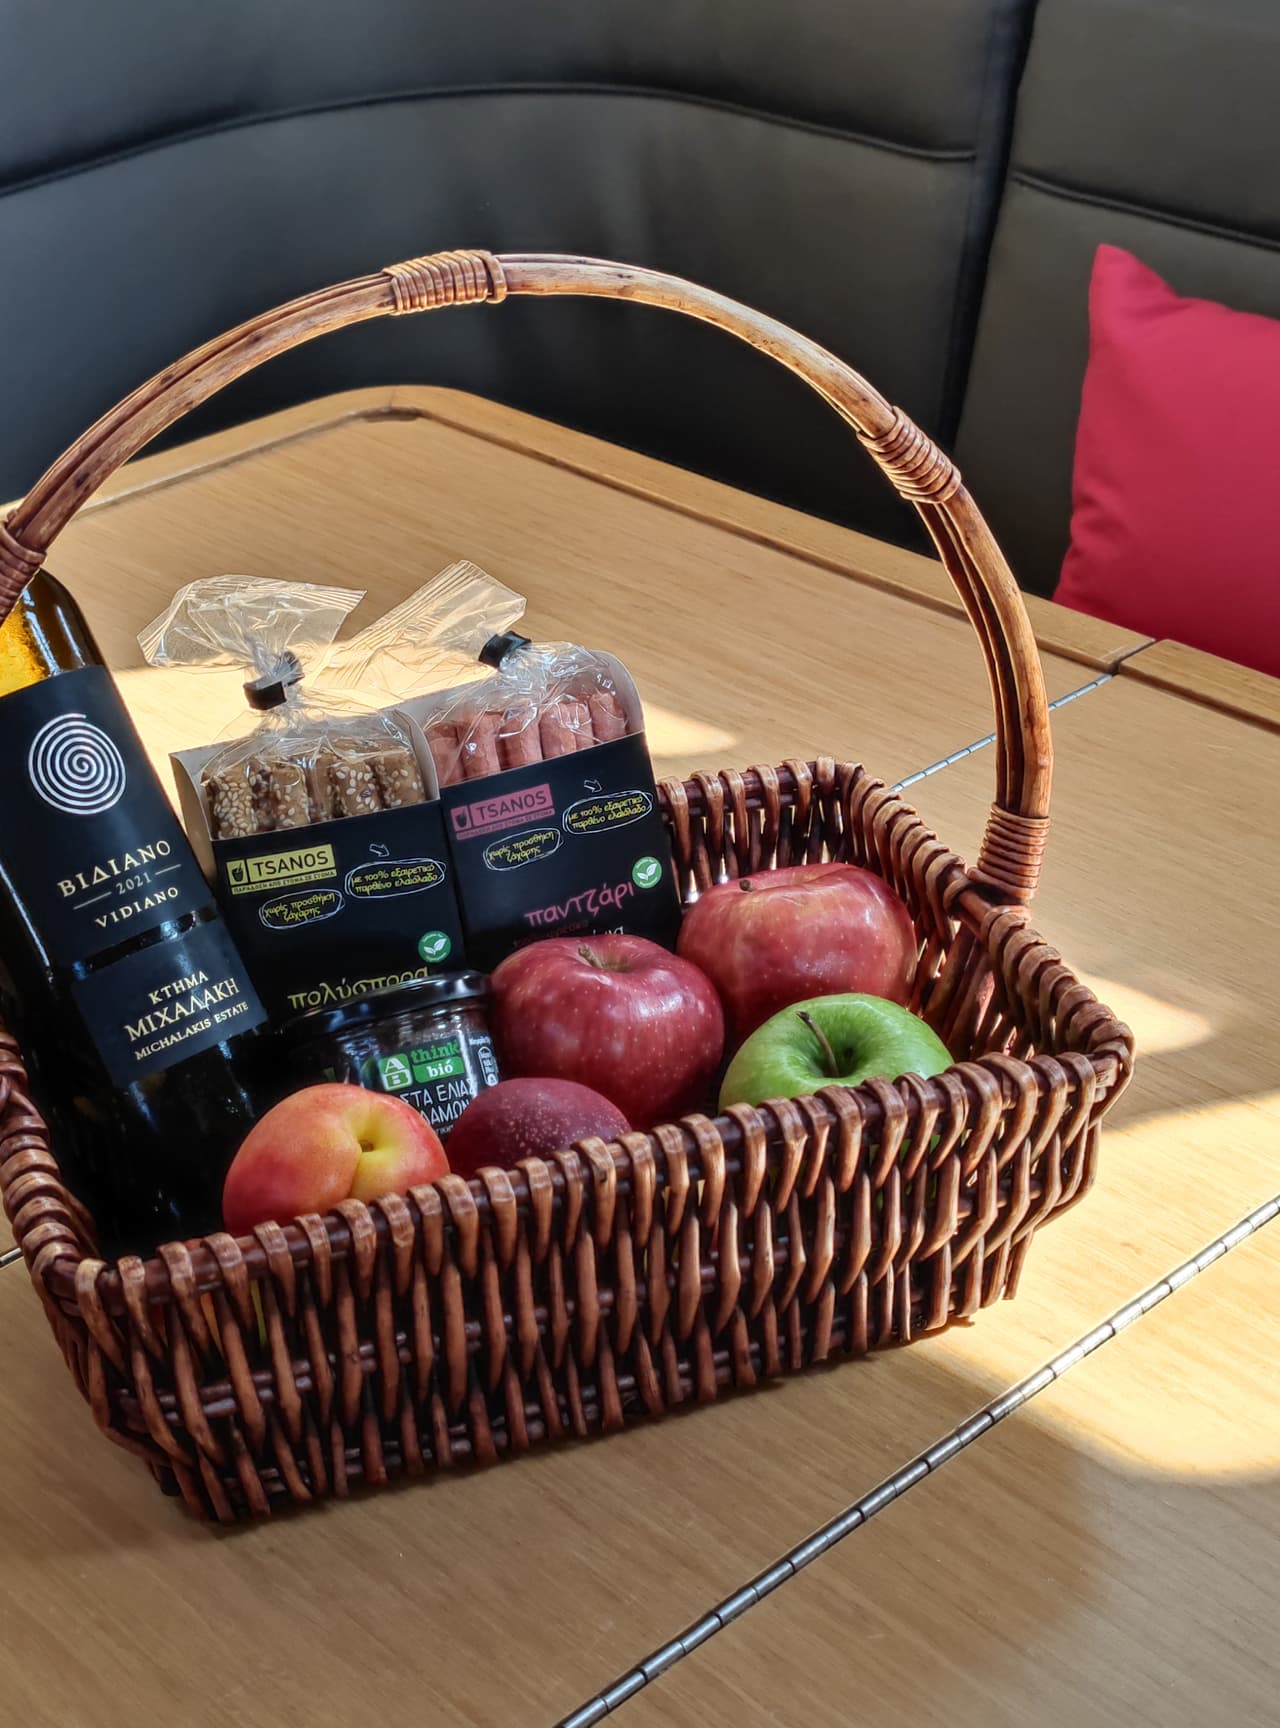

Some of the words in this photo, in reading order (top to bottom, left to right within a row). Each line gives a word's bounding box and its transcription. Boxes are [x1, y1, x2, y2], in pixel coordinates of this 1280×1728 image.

[476, 790, 547, 820] TSANOS
[580, 804, 603, 817] 100%
[57, 840, 171, 897] ΒΙΔΙΑΝΟ
[252, 850, 329, 877] TSANOS
[365, 870, 390, 881] 100%
[115, 871, 152, 895] 2021
[95, 887, 179, 928] VIDIANO
[523, 881, 635, 927] παντζάρι
[148, 970, 209, 1005] ΚΤΗΜΑ
[123, 978, 240, 1042] ΜΙΧΑΛΑΚΗ
[134, 1018, 212, 1061] MICHALAKIS
[213, 1001, 249, 1024] ESTATE
[411, 1039, 460, 1063] think
[426, 1058, 455, 1079] bió
